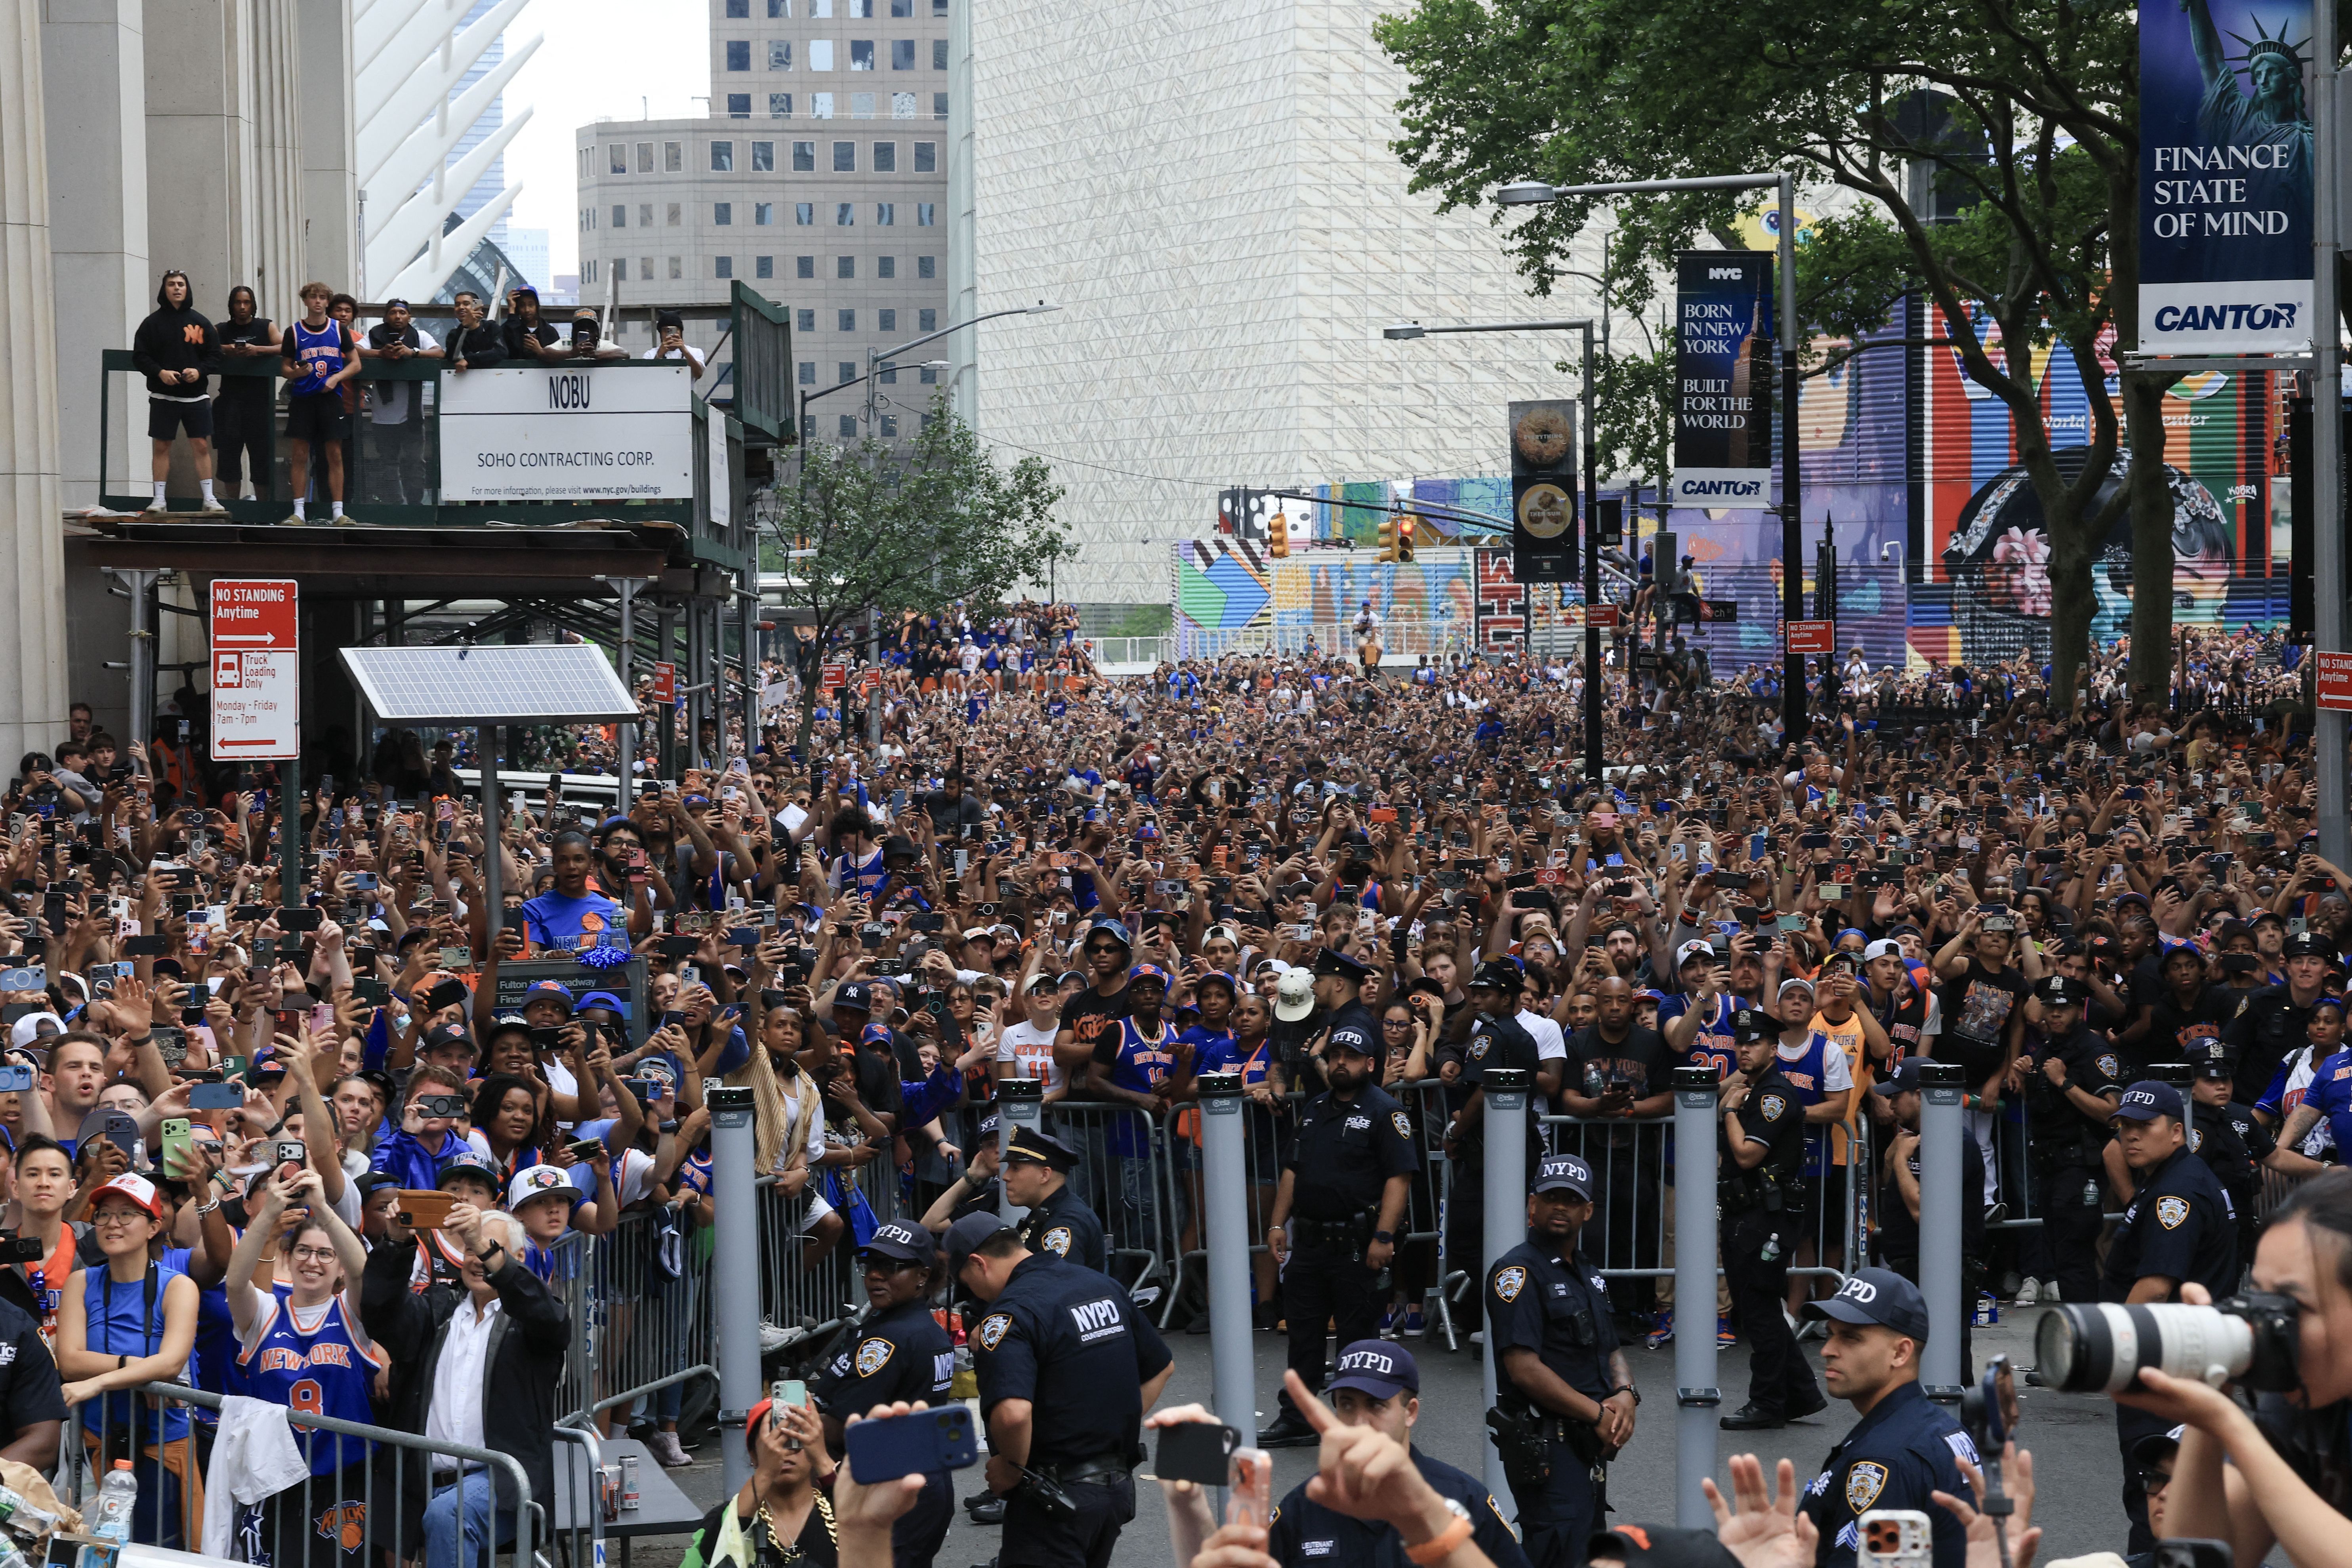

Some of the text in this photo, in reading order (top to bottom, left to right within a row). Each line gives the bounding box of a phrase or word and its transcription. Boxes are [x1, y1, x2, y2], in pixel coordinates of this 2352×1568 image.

[2154, 144, 2289, 171] FINANCE
[2154, 179, 2247, 204] STATE
[2154, 210, 2289, 238] OF MIND
[1709, 268, 1742, 280] NYC
[1684, 304, 1732, 318] BORN
[2155, 303, 2297, 332] CANTOR
[1684, 322, 1745, 336] IN NEW
[1684, 340, 1731, 353] YORK
[315, 361, 327, 378] 9
[549, 376, 590, 409] NOBU
[1683, 379, 1729, 393] BUILT
[1683, 397, 1753, 410] FOR THE
[1682, 414, 1745, 428] WORLD
[2161, 414, 2210, 427] enter
[478, 452, 654, 467] SOHO CONTRACTING CORP.
[503, 486, 543, 496] information,
[545, 486, 567, 496] please
[583, 484, 661, 495] www.nyc.gov/buildings
[1682, 480, 1761, 495] CANTOR
[2227, 485, 2257, 496] KOBRA
[216, 588, 285, 602] NO STANDING
[216, 605, 260, 621] Anytime
[245, 654, 268, 665] Truck
[2320, 658, 2330, 668] NO
[245, 666, 276, 678] Loading
[2320, 671, 2348, 684] Anytime
[245, 678, 263, 690] Only
[217, 700, 246, 712] Monday
[254, 700, 277, 712] Friday
[217, 714, 233, 724] 7am
[240, 713, 257, 725] 7pm
[500, 980, 527, 989] Fulton
[845, 986, 858, 998] NY
[499, 1015, 527, 1025] QUEEN
[1331, 1030, 1363, 1045] NYPD
[1833, 1034, 1858, 1046] YORK
[1015, 1044, 1054, 1057] NEW YO
[1133, 1052, 1152, 1065] NEW
[1028, 1061, 1050, 1086] 11
[1690, 1052, 1728, 1082] 20
[1148, 1067, 1164, 1082] 11
[2119, 1091, 2156, 1105] NYPD
[980, 1117, 998, 1132] NY
[1347, 1117, 1372, 1126] POLICE
[1542, 1162, 1587, 1182] NYPD
[872, 1224, 912, 1244] NYPD
[1070, 1299, 1120, 1333] NYPD
[1080, 1324, 1125, 1342] COUNTERTERRORISM
[260, 1342, 352, 1374] NEW YORK
[1338, 1351, 1393, 1374] NYPD
[288, 1378, 324, 1433] 8
[1301, 1540, 1334, 1549] LIEUTENANT
